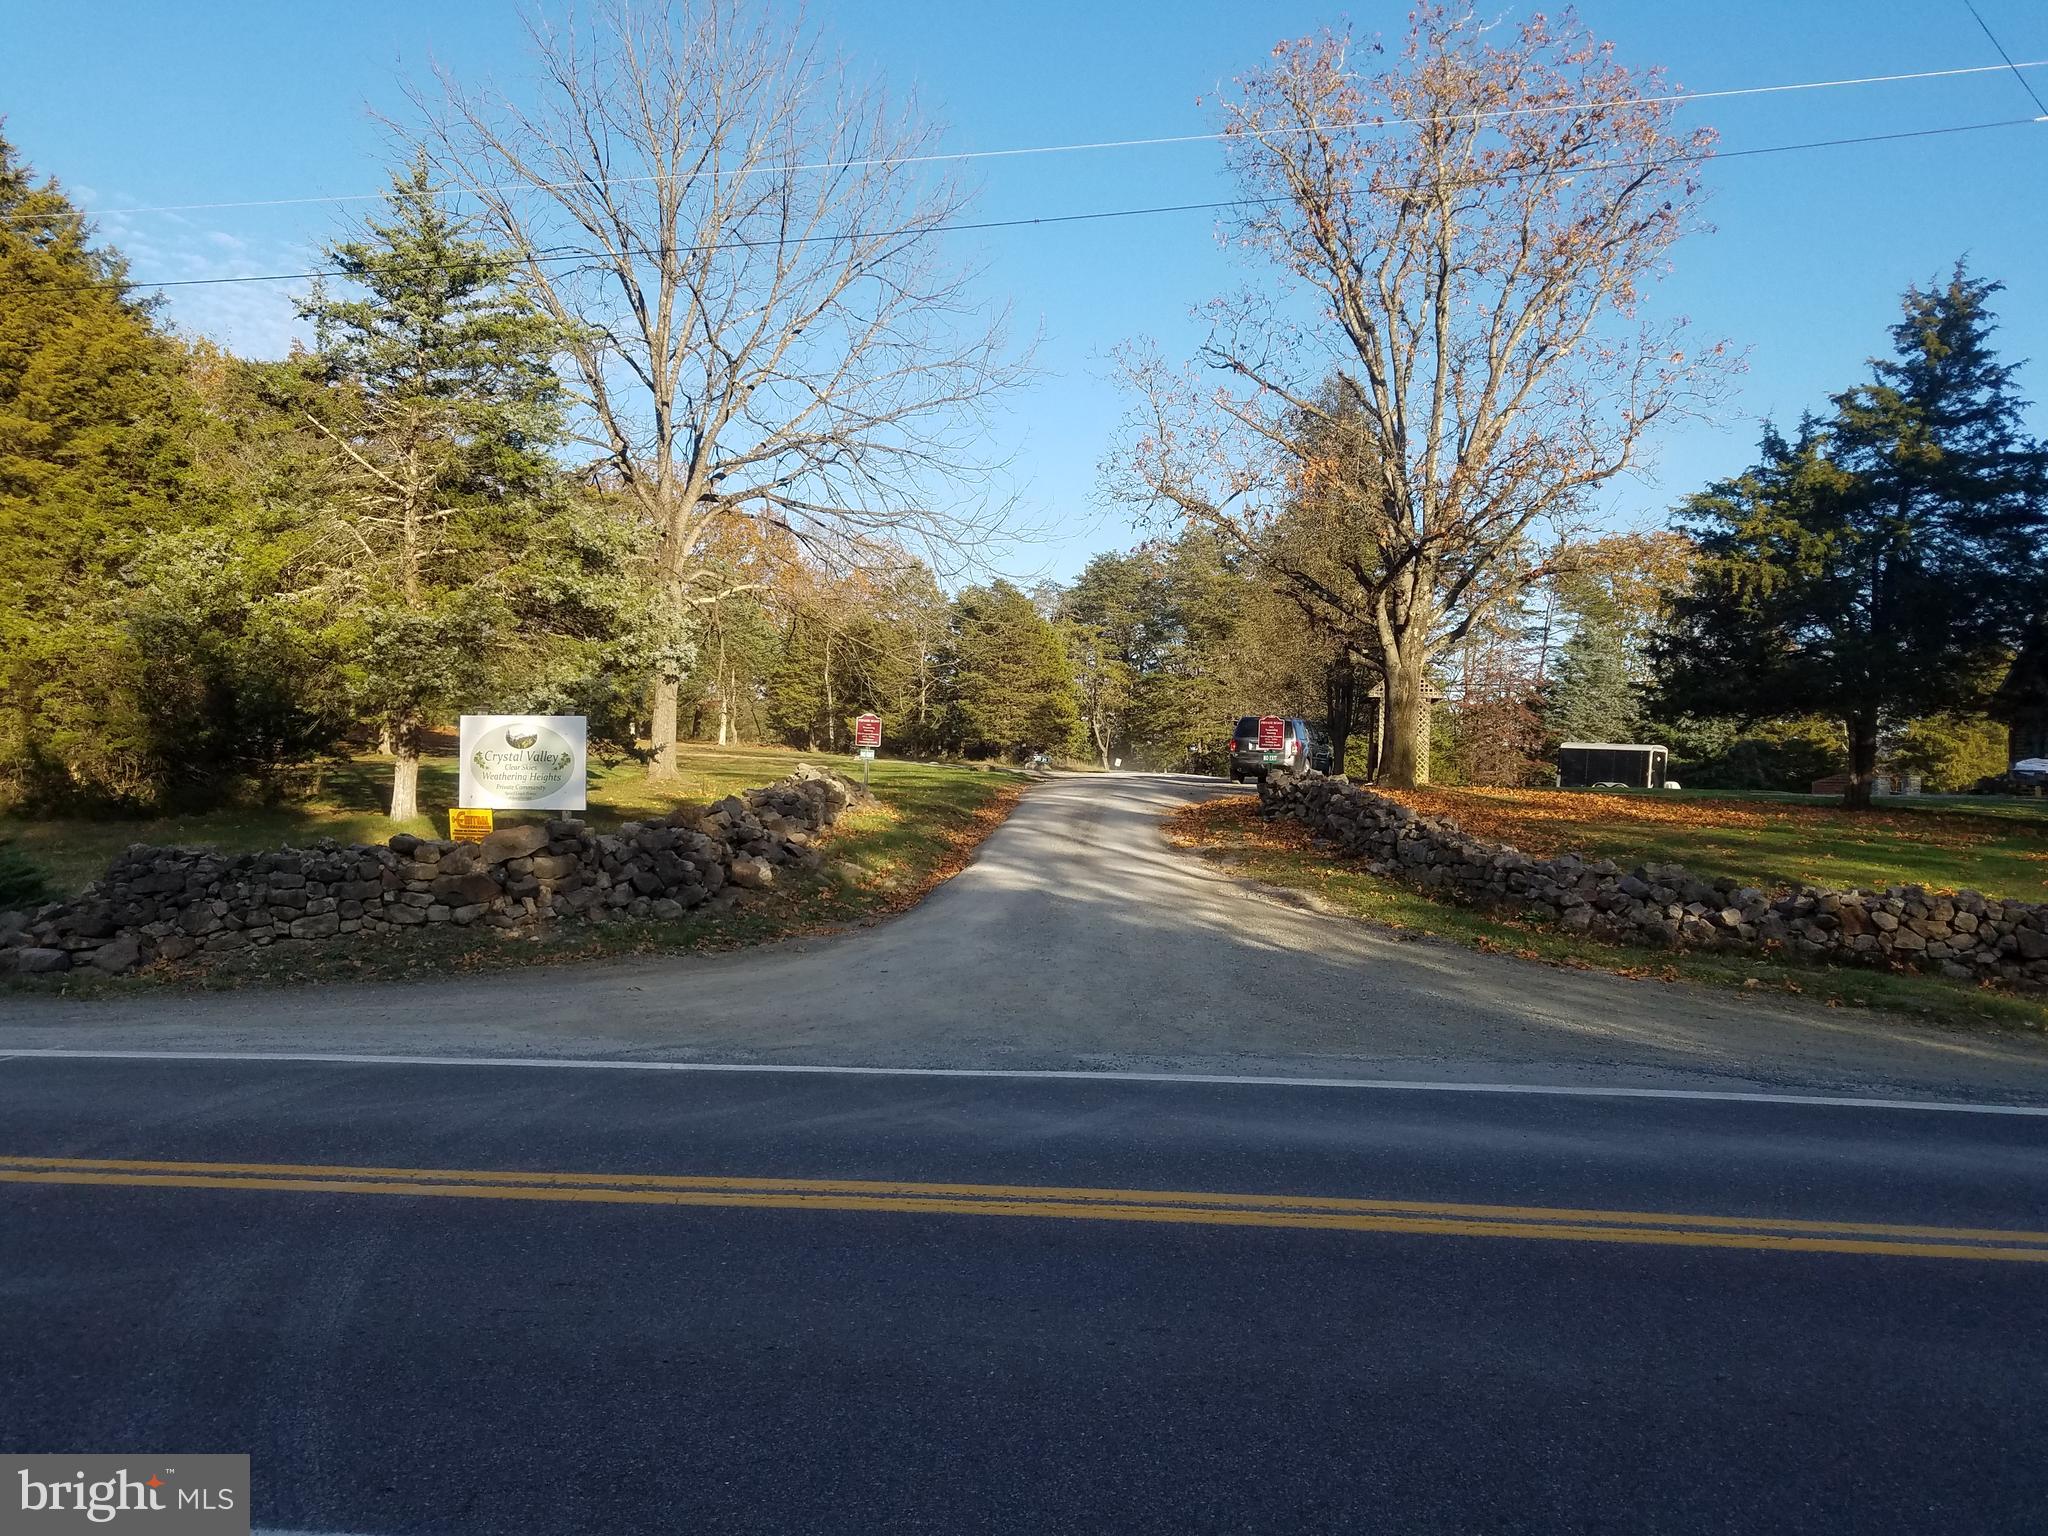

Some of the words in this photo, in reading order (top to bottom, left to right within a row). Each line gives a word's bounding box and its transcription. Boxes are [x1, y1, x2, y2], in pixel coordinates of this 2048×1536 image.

[484, 750, 524, 764] Crystal
[527, 750, 559, 765] Valley
[482, 772, 527, 783] Weathering
[530, 772, 562, 783] Heights
